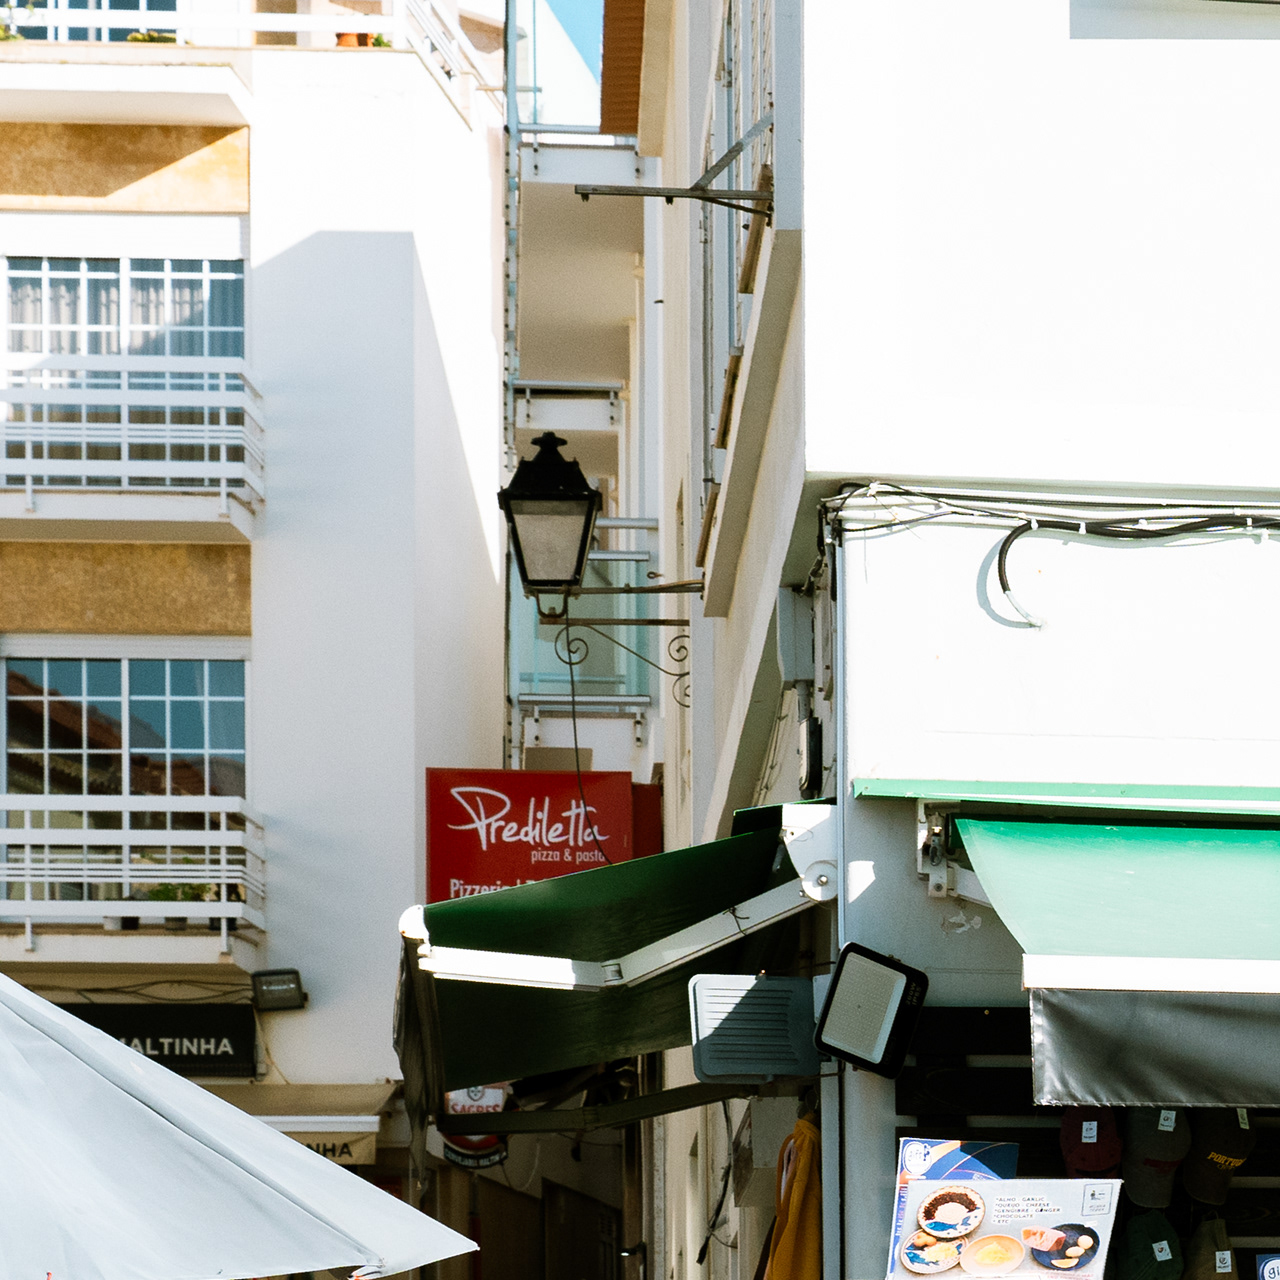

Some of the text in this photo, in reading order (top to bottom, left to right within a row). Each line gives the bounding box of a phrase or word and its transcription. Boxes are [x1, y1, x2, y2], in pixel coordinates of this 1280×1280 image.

[447, 786, 610, 850] Prediletta
[531, 848, 606, 864] pizza & pasta
[120, 1037, 234, 1056] ALTINHA
